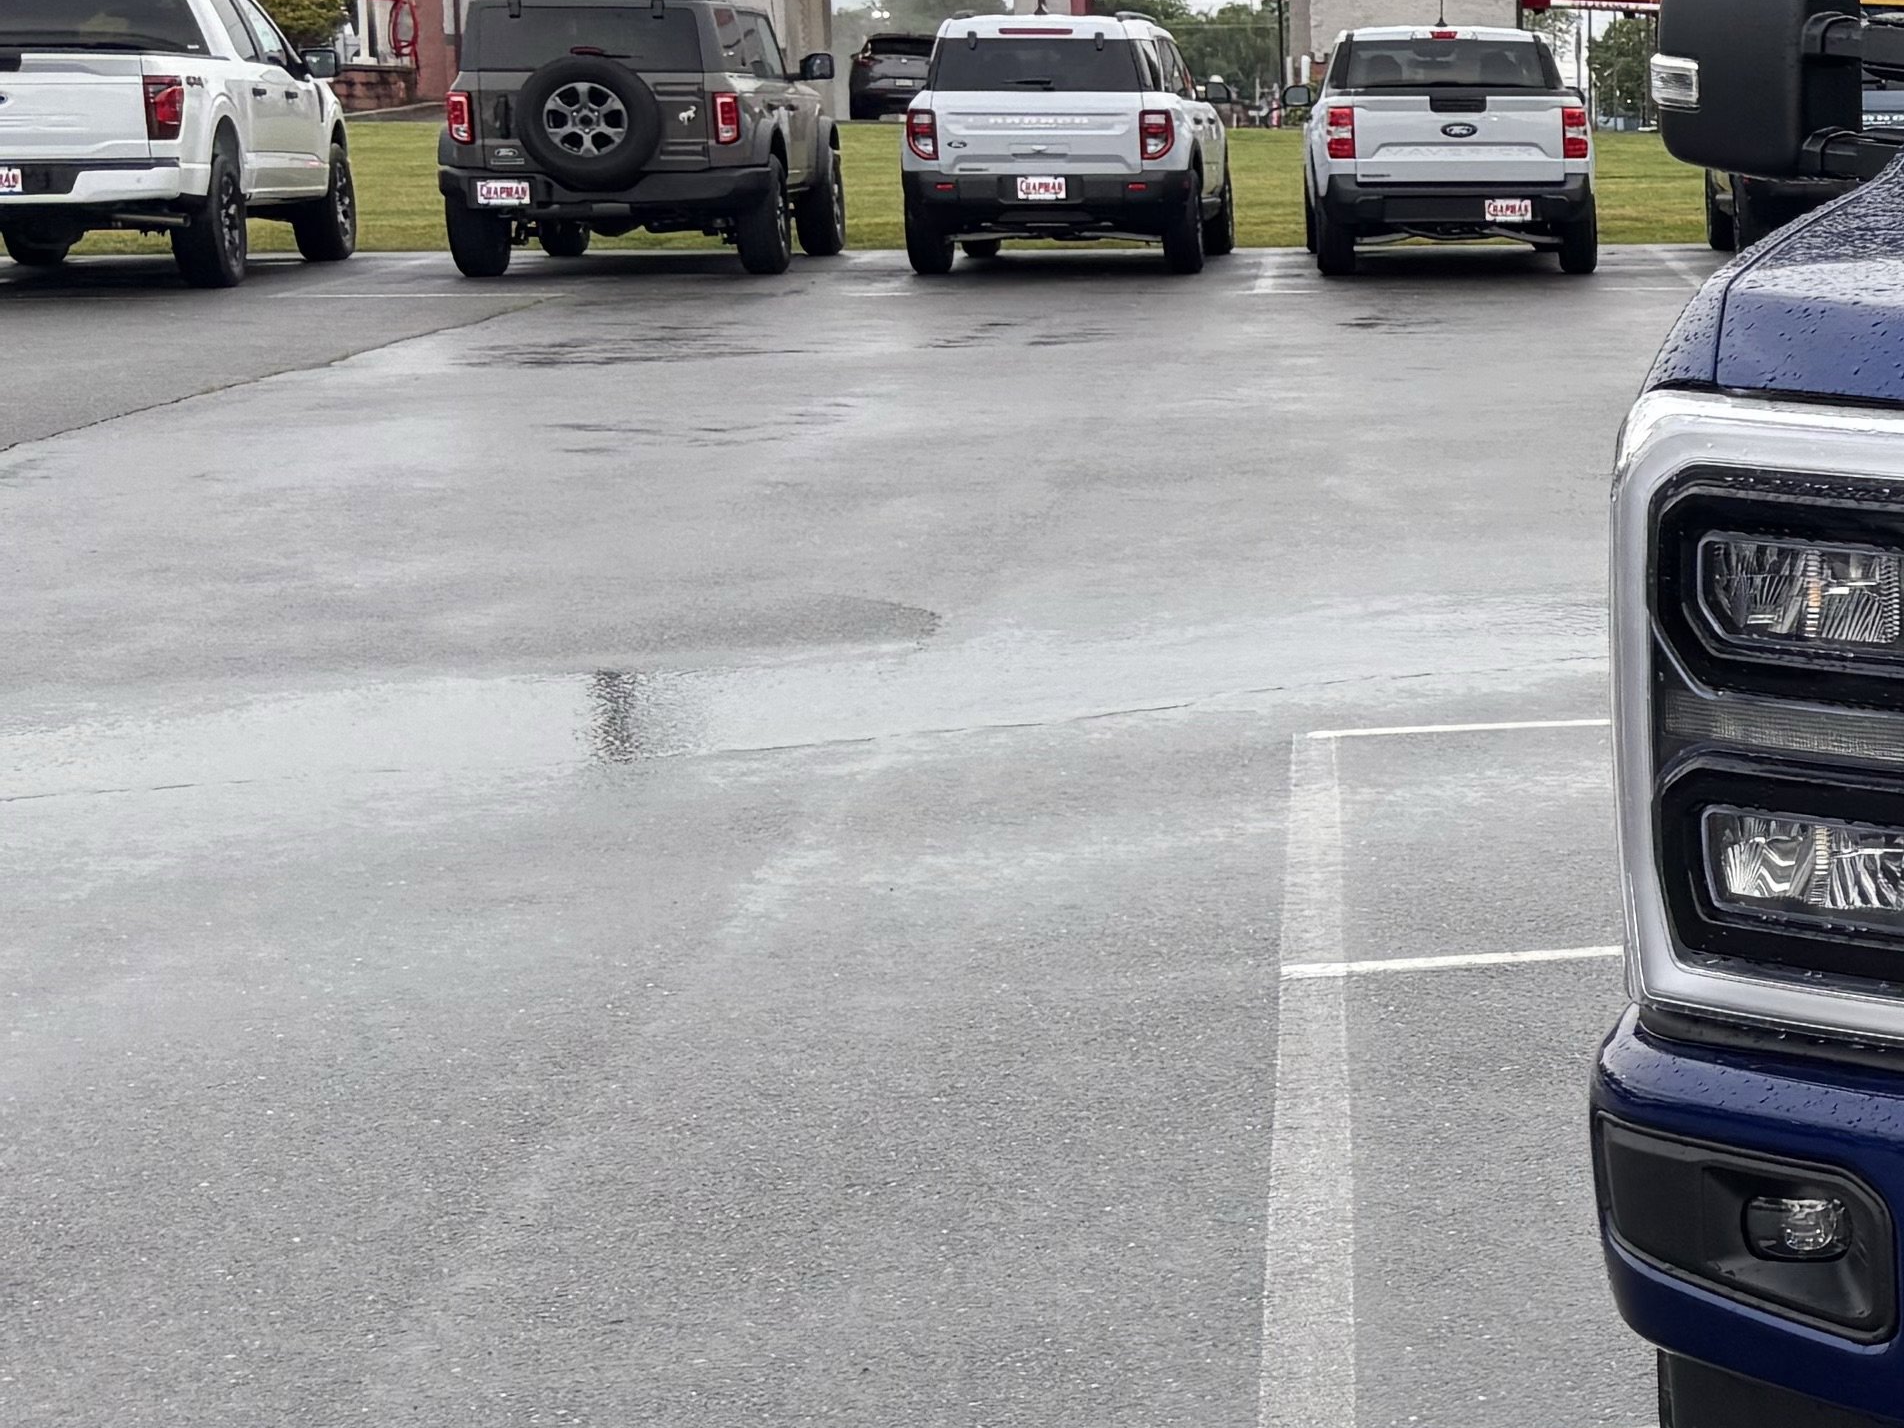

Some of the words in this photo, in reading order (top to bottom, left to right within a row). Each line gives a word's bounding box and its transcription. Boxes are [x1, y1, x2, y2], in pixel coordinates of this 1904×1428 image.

[480, 184, 527, 198] CHAPMAN
[1020, 180, 1063, 194] CHAPMAN
[1488, 202, 1529, 216] CHAPMAN
